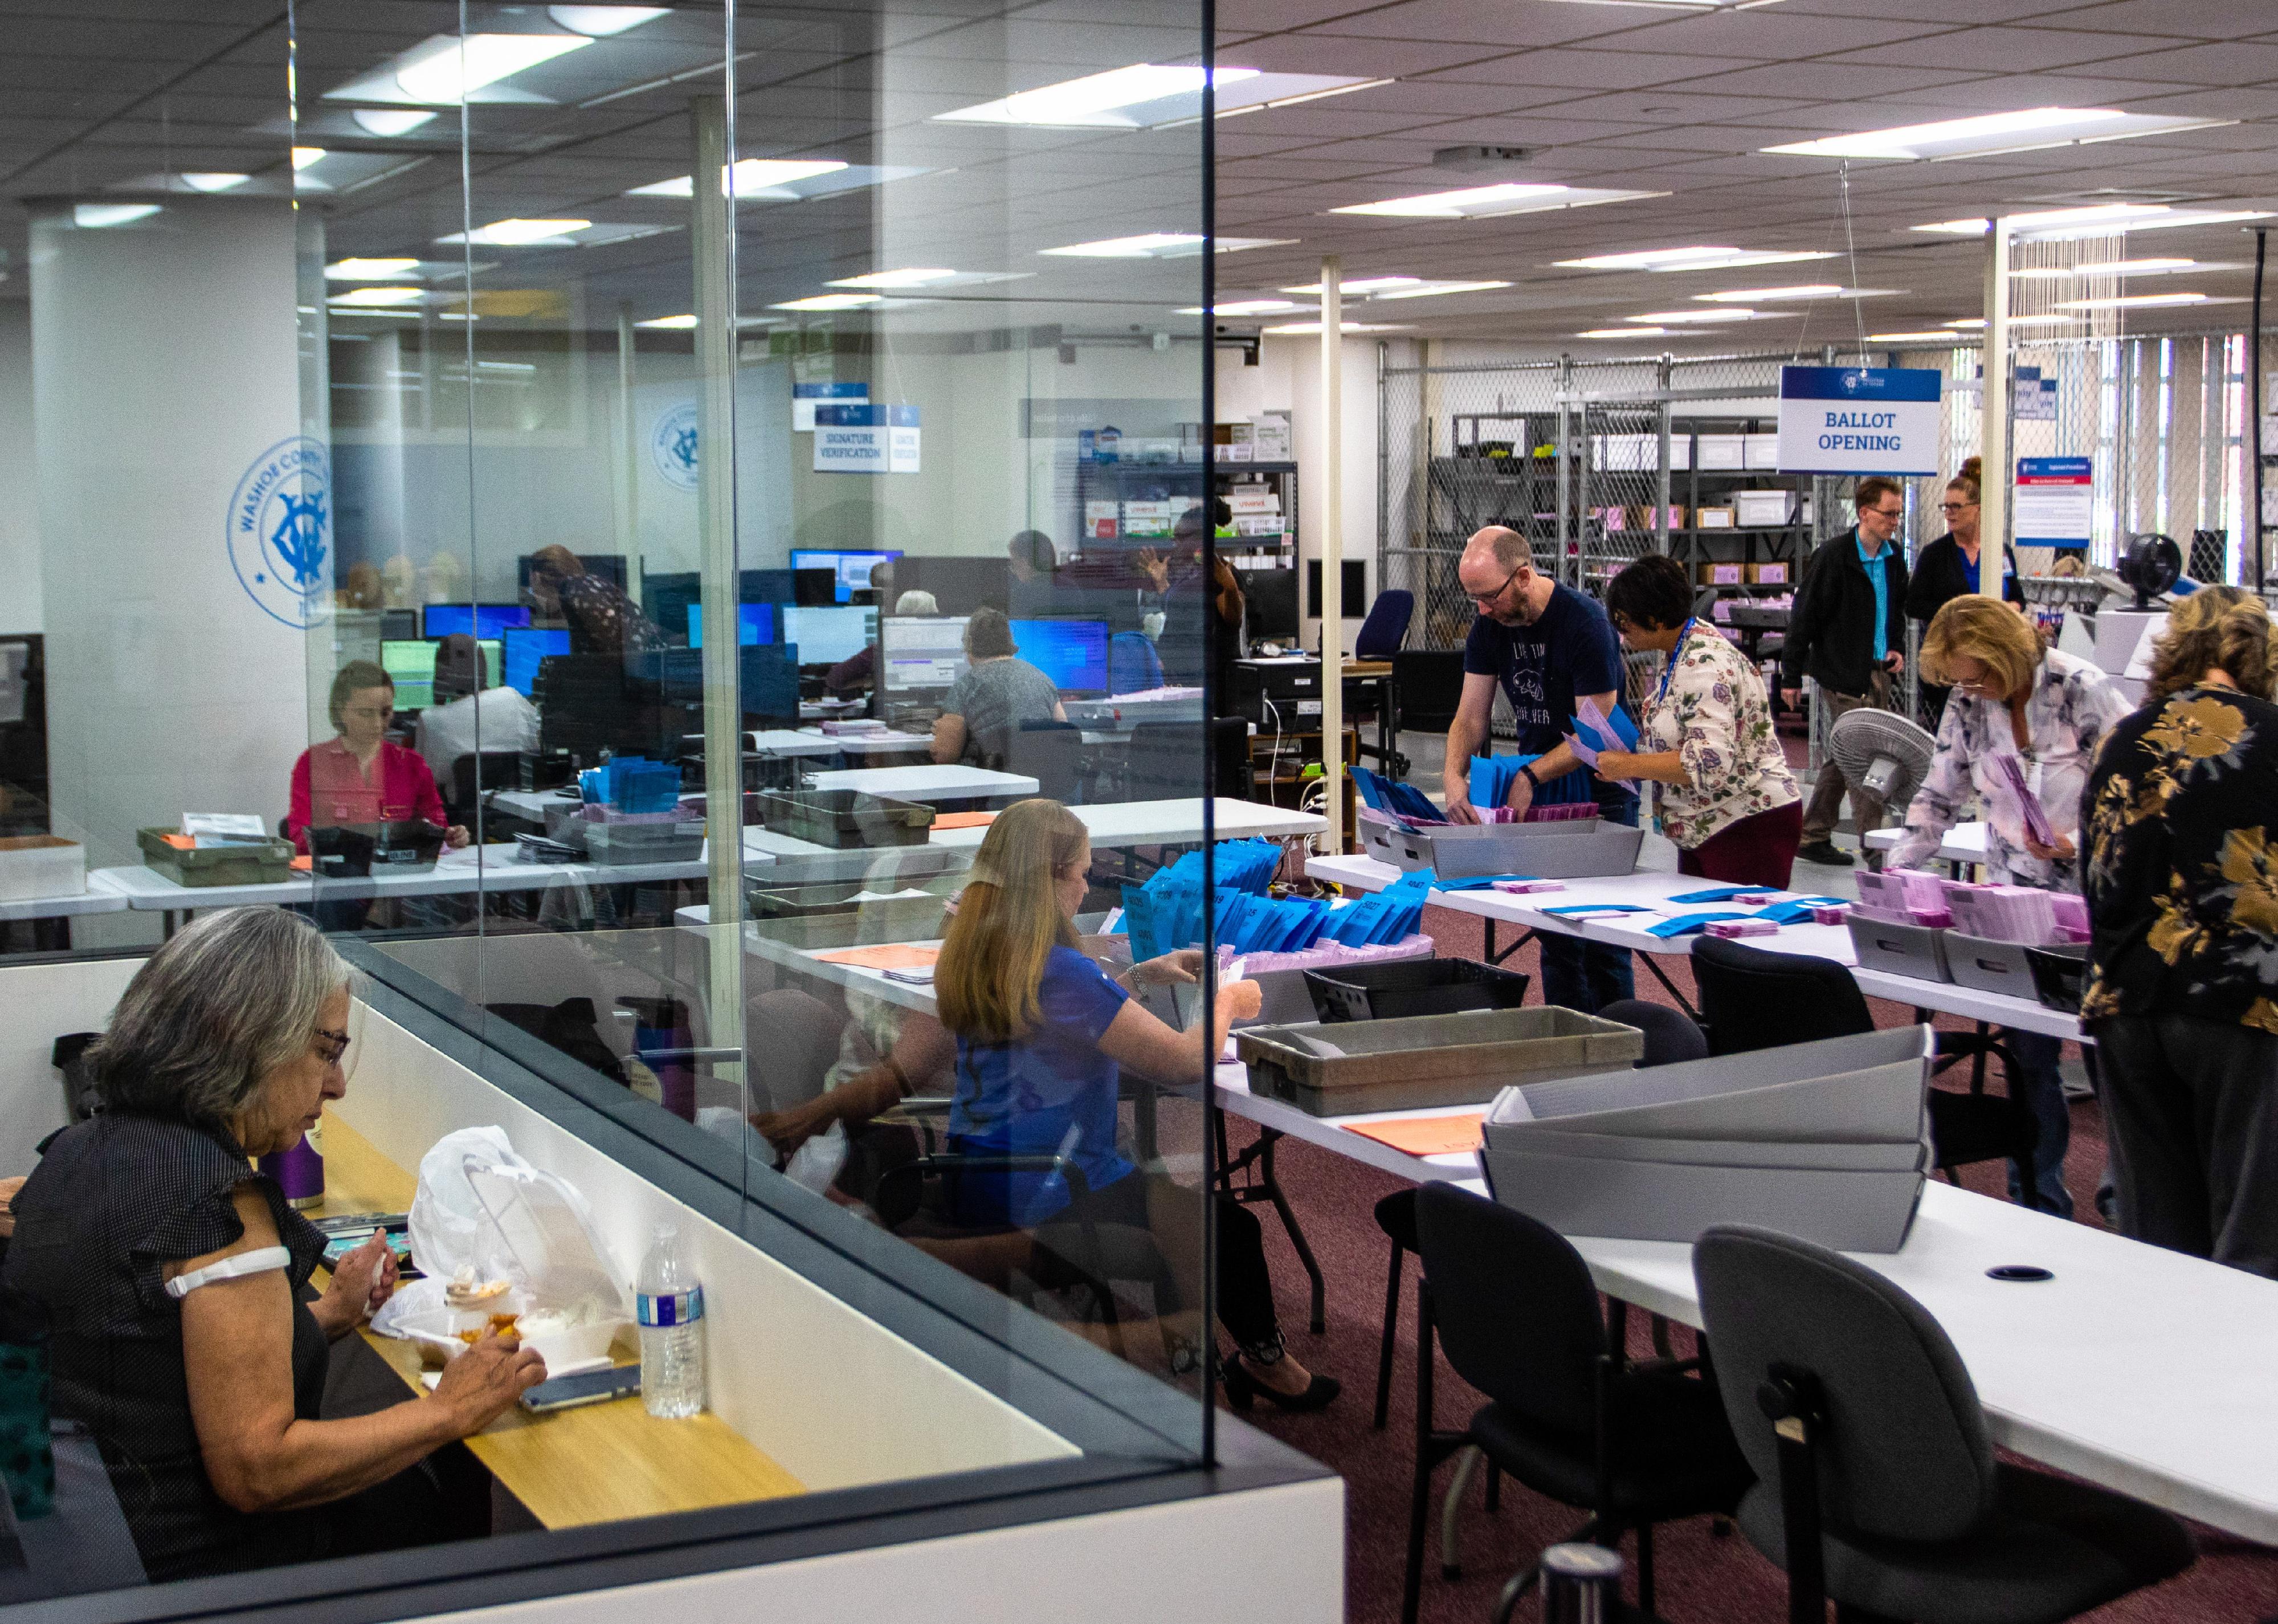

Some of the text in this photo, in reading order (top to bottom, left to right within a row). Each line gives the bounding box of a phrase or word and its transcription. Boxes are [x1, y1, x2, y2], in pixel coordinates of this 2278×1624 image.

[1825, 411, 1896, 428] BALLOT
[826, 433, 875, 444] SIGNATURE
[1818, 434, 1901, 451] OPENING
[820, 447, 881, 459] VERIFICATION
[240, 463, 280, 532] WASHOE
[1362, 901, 1381, 910] 5027
